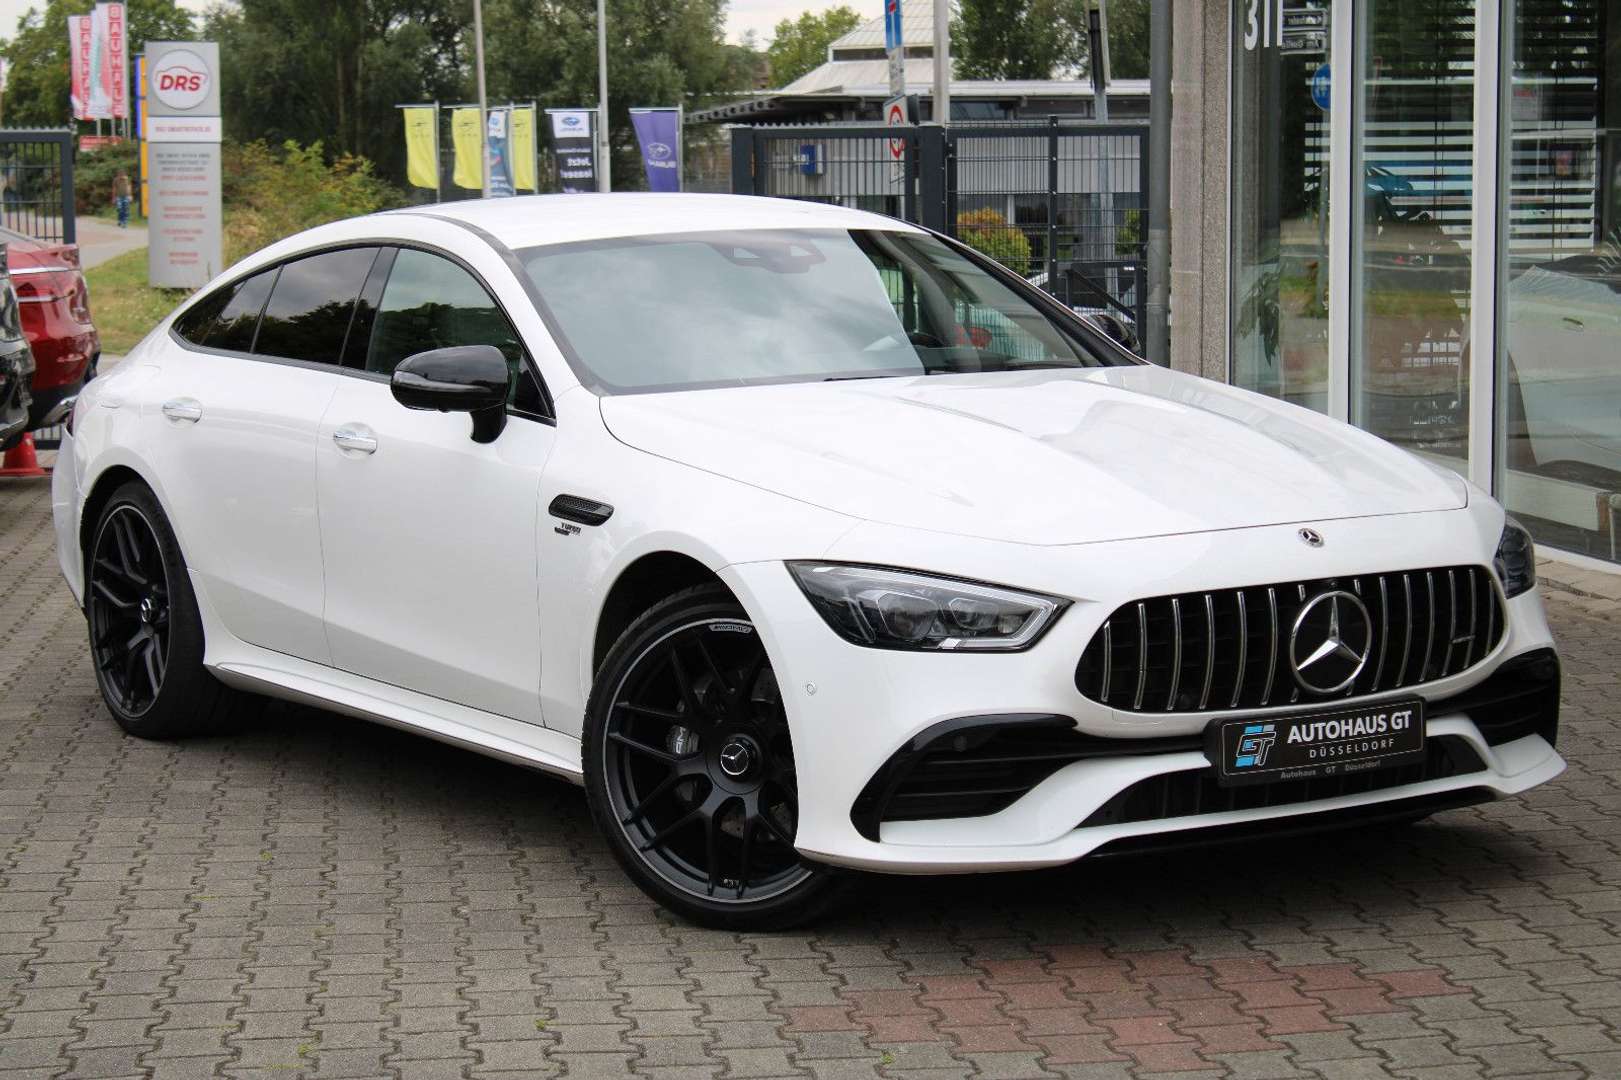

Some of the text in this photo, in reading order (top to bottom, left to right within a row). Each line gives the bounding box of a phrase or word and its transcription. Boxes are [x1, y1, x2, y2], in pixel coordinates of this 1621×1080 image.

[109, 3, 124, 118] BAUHAUS
[160, 75, 201, 92] DRS
[1287, 711, 1412, 744] AUTOHAUS GT
[1309, 738, 1395, 758] DÜSSELDORF
[1280, 760, 1381, 780] Autohaus GT Düsseldorf
